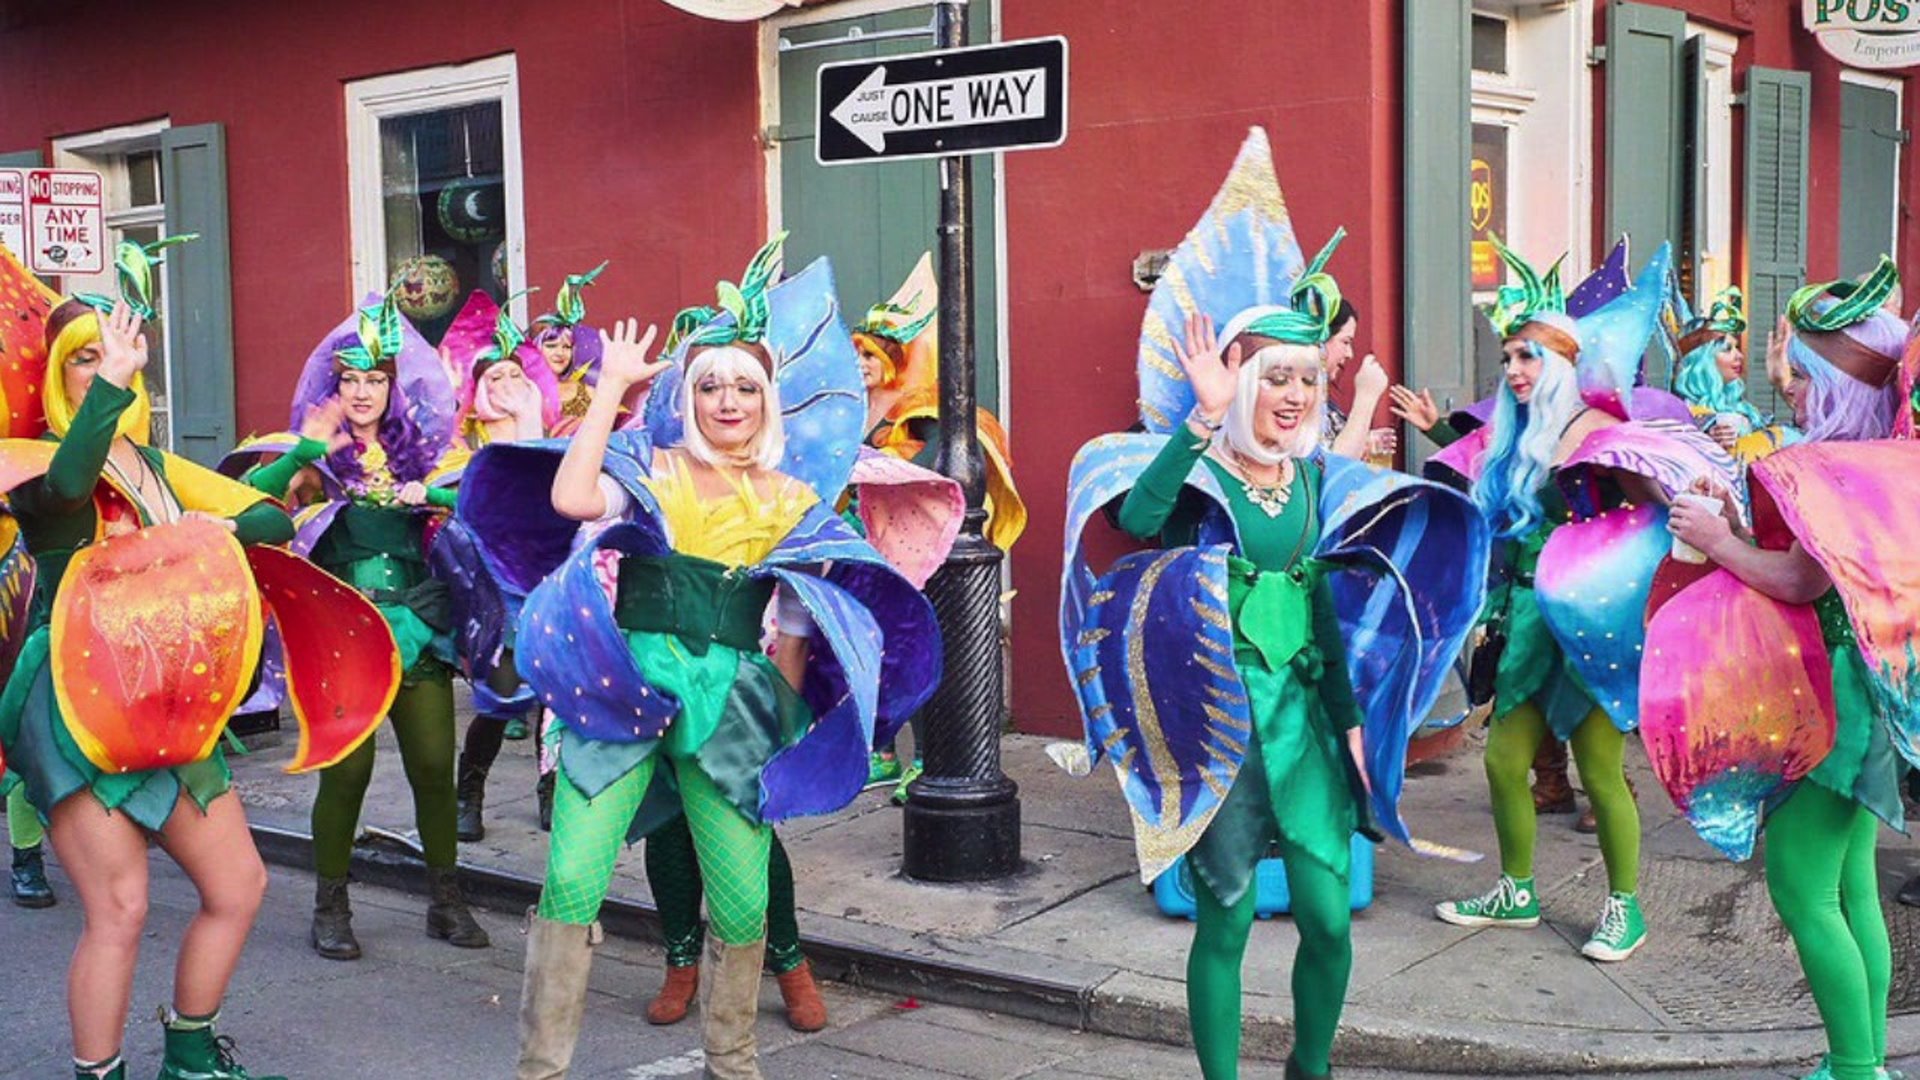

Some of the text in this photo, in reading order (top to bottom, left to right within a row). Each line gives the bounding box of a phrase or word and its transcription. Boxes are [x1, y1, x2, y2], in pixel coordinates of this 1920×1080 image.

[1815, 0, 1920, 24] POS
[1854, 38, 1920, 61] Emporiu
[857, 90, 885, 103] JUST
[891, 74, 1036, 126] ONE WAY
[851, 110, 888, 124] CAUSE
[30, 173, 98, 199] NO STOPPING
[1472, 182, 1489, 219] ps
[45, 209, 87, 224] ANY
[45, 226, 89, 244] TIME
